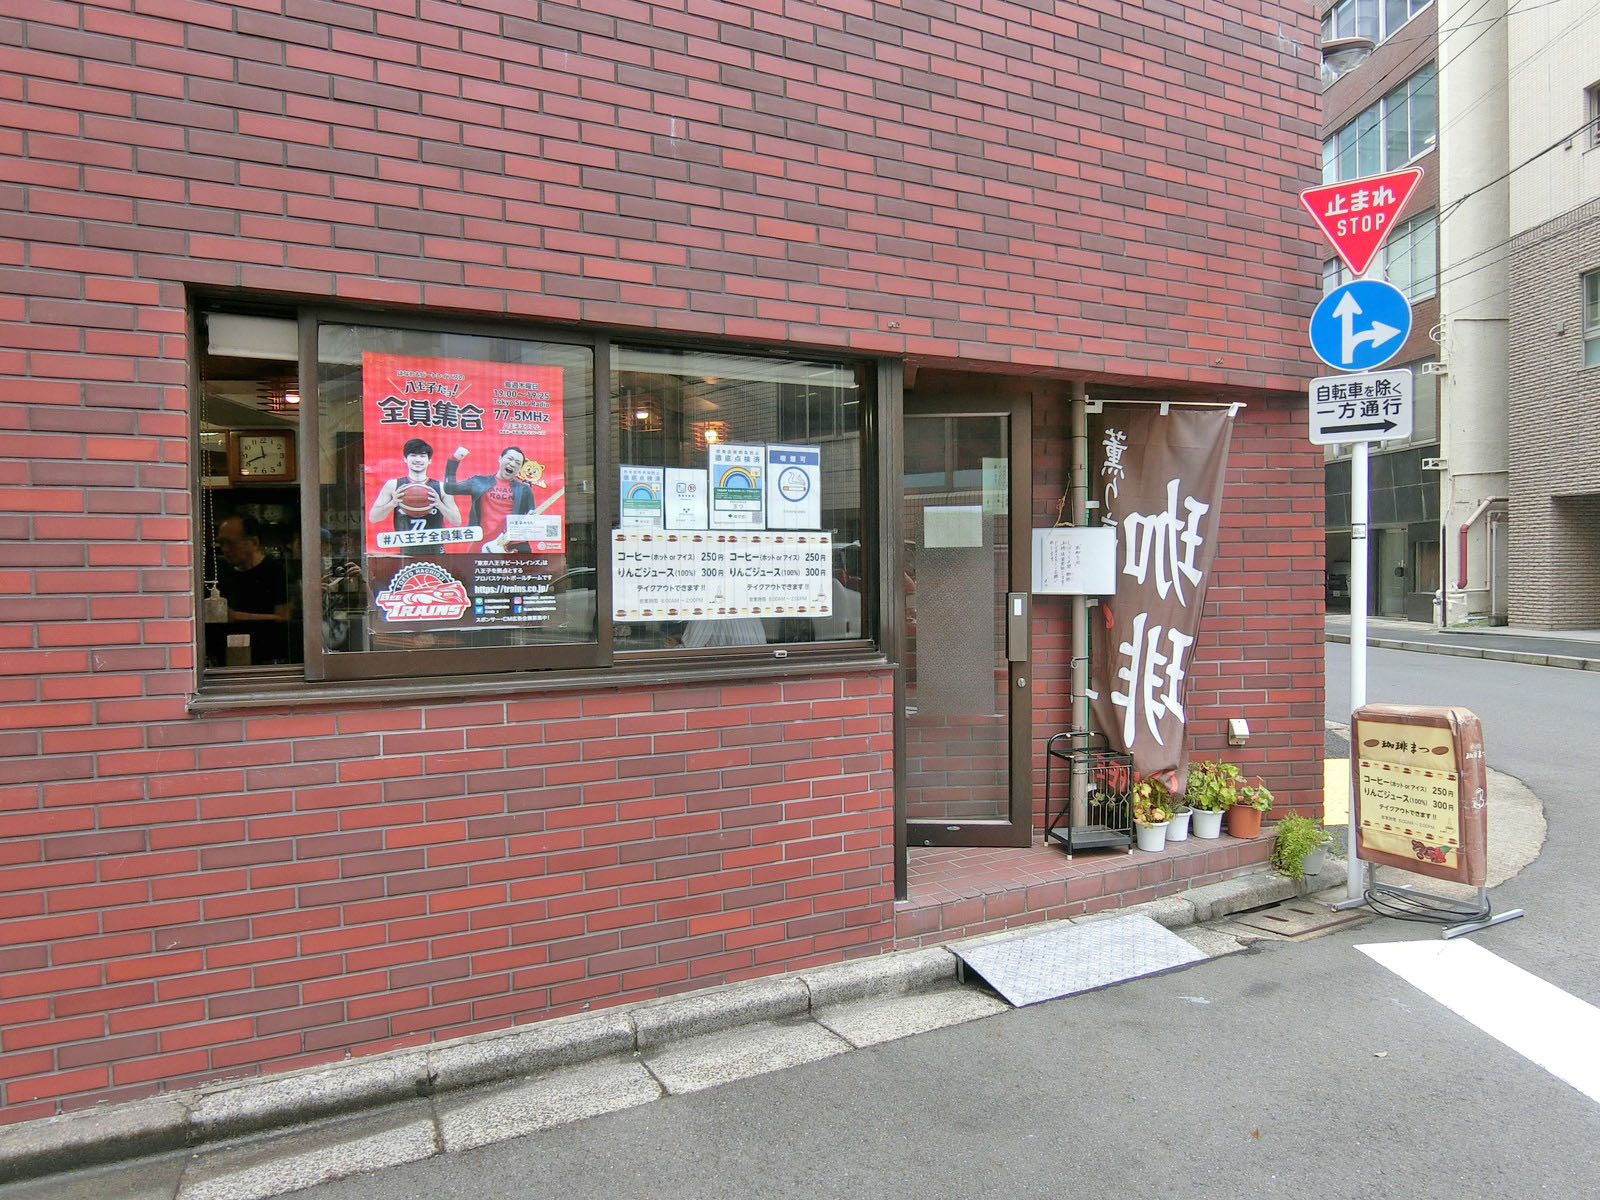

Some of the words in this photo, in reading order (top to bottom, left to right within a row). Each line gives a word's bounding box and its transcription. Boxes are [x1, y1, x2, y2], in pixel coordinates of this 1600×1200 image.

[1324, 185, 1397, 217] 止まれ
[1336, 212, 1386, 237] STOP
[1316, 379, 1402, 402] 自転車を除く
[493, 398, 514, 407] Tokyo
[1316, 398, 1403, 420] 一方通行
[376, 394, 486, 432] 全員集合
[494, 409, 550, 422] 77.5MHz
[384, 530, 474, 545] #八王子全員集合
[701, 552, 724, 562] 250円
[805, 553, 826, 562] 250円
[701, 568, 724, 577] 300円
[805, 568, 826, 577] 300円
[1382, 740, 1430, 754] 珈琲まつ
[1432, 786, 1454, 798] 250円
[1432, 800, 1454, 812] 300円
